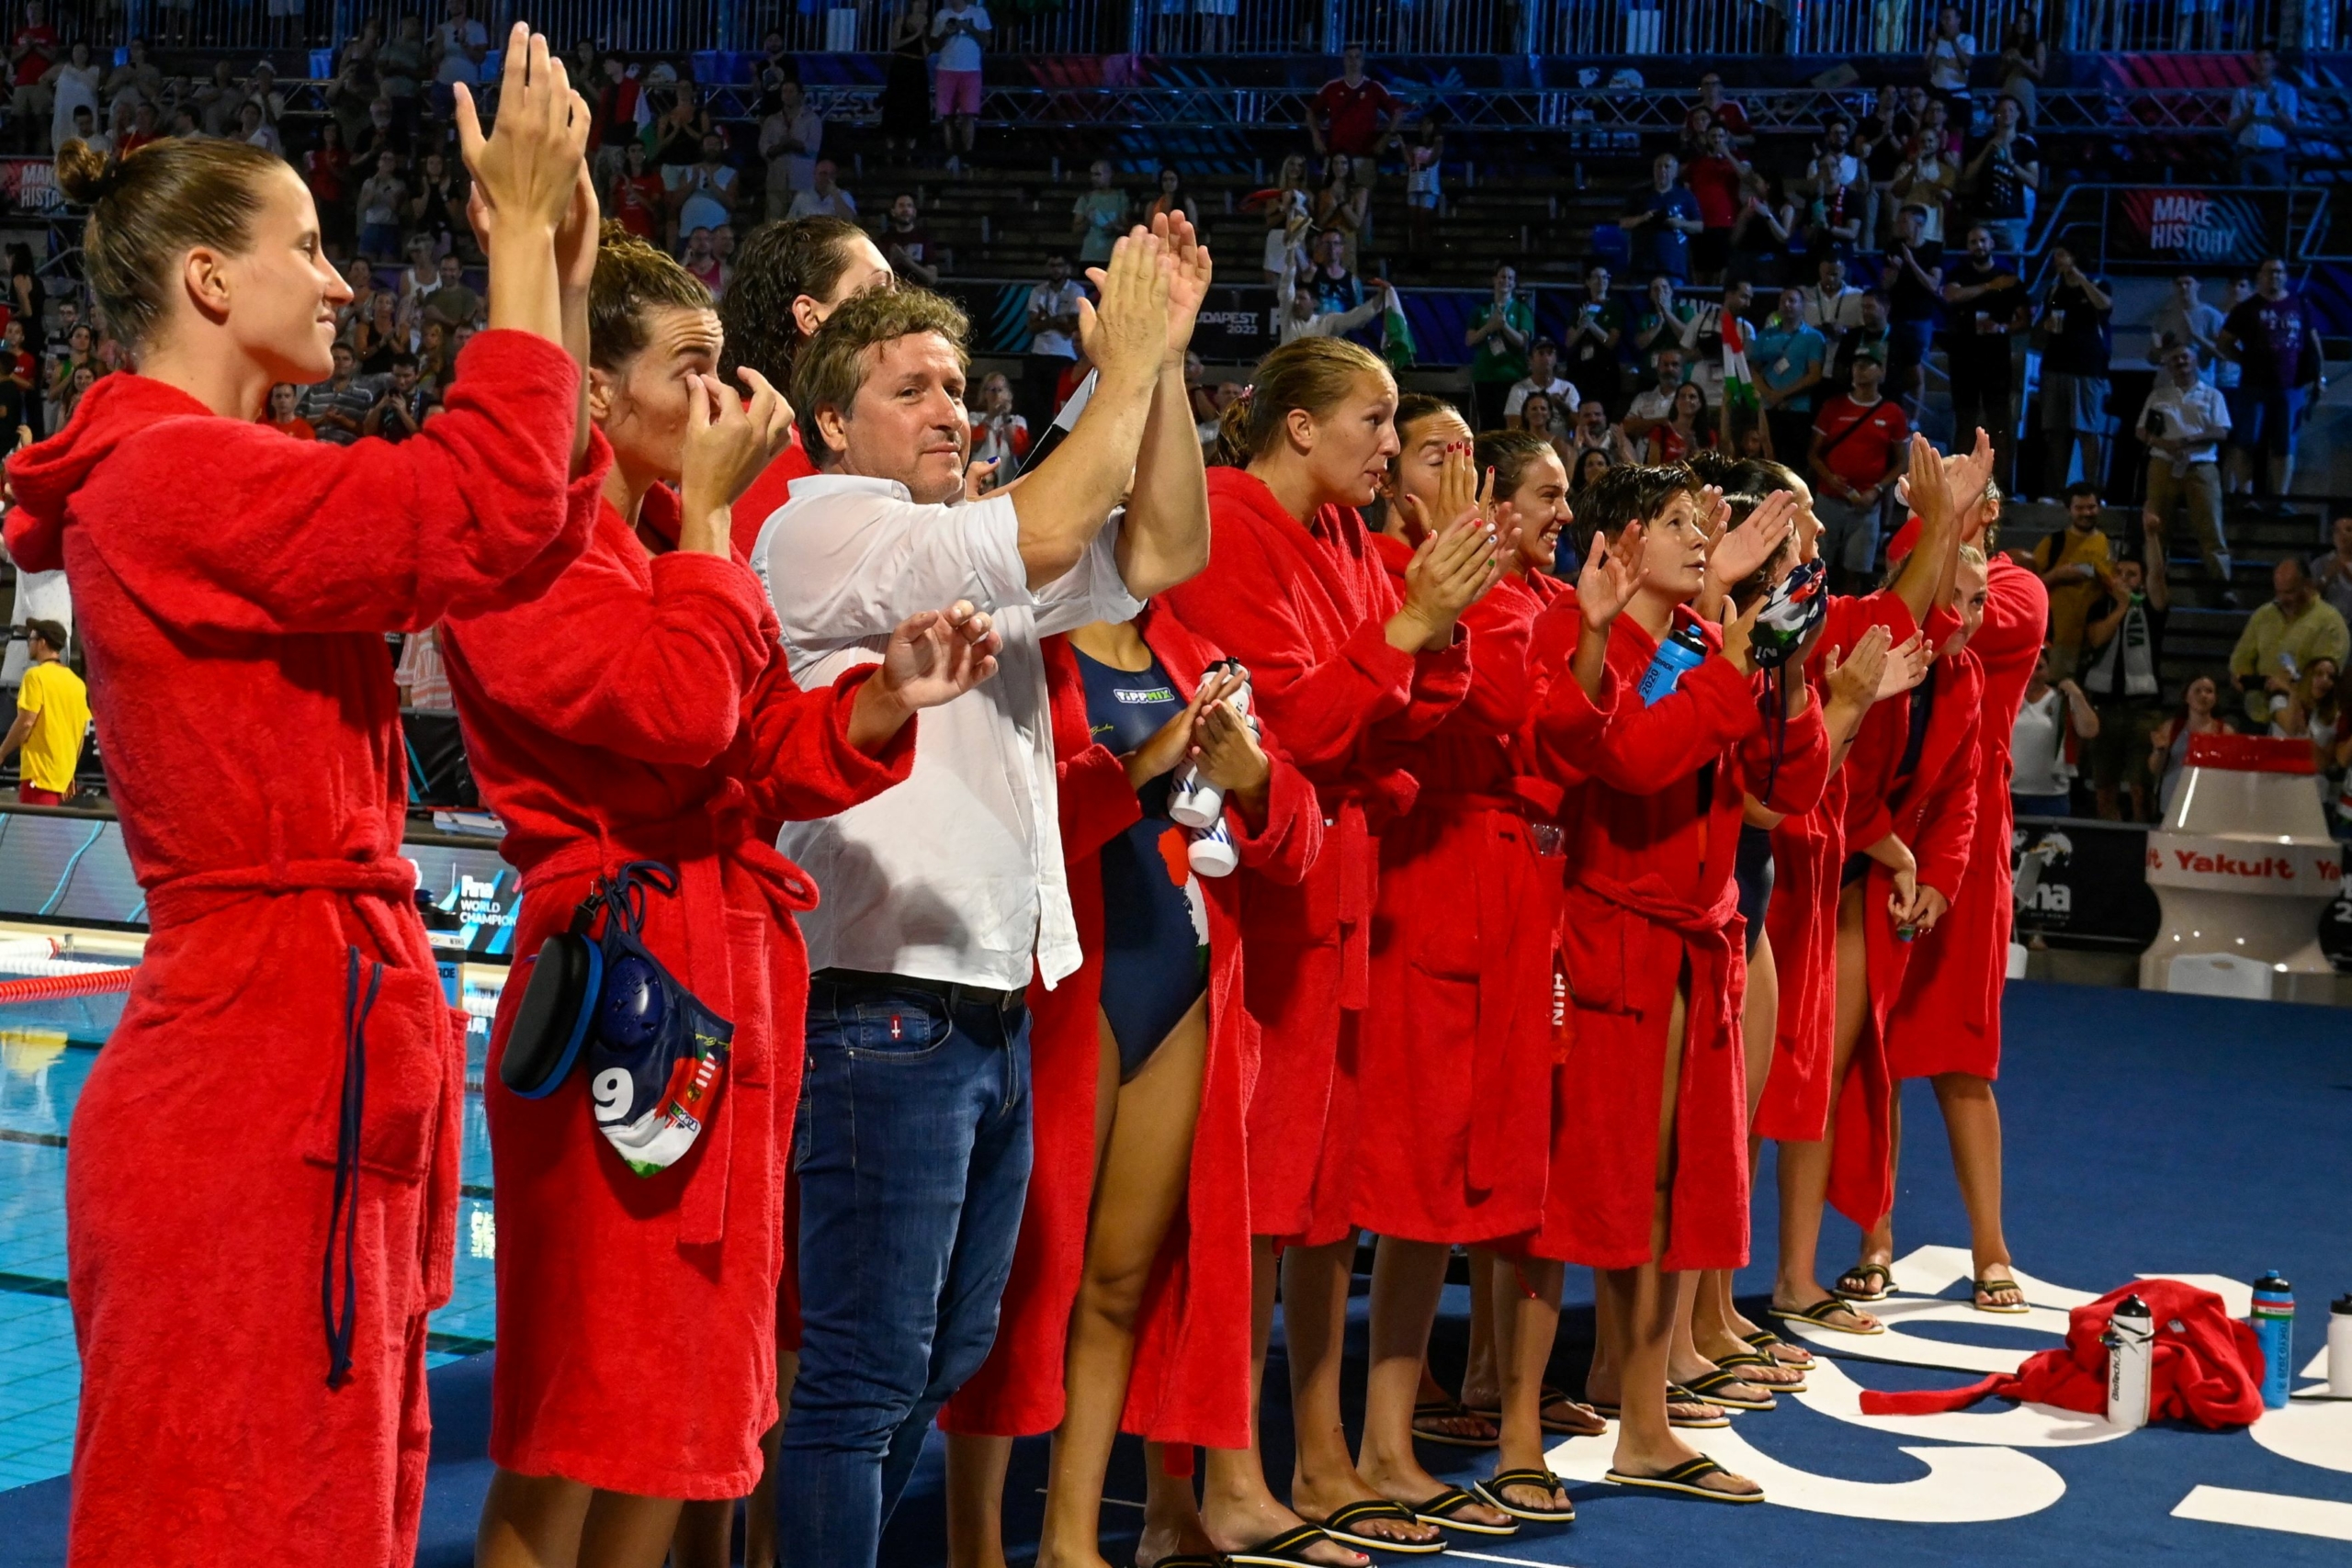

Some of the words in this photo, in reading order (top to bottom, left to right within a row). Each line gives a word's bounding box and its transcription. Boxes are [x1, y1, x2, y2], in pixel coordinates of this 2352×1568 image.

[2152, 196, 2212, 227] MAKE
[2150, 223, 2236, 254] HISTORY
[1641, 669, 1659, 694] 2020
[2174, 849, 2295, 880] Yakult
[459, 911, 516, 927] CHAMPION
[460, 900, 501, 913] WORLD
[1552, 973, 1566, 1026] HUN
[592, 1066, 634, 1122] 9
